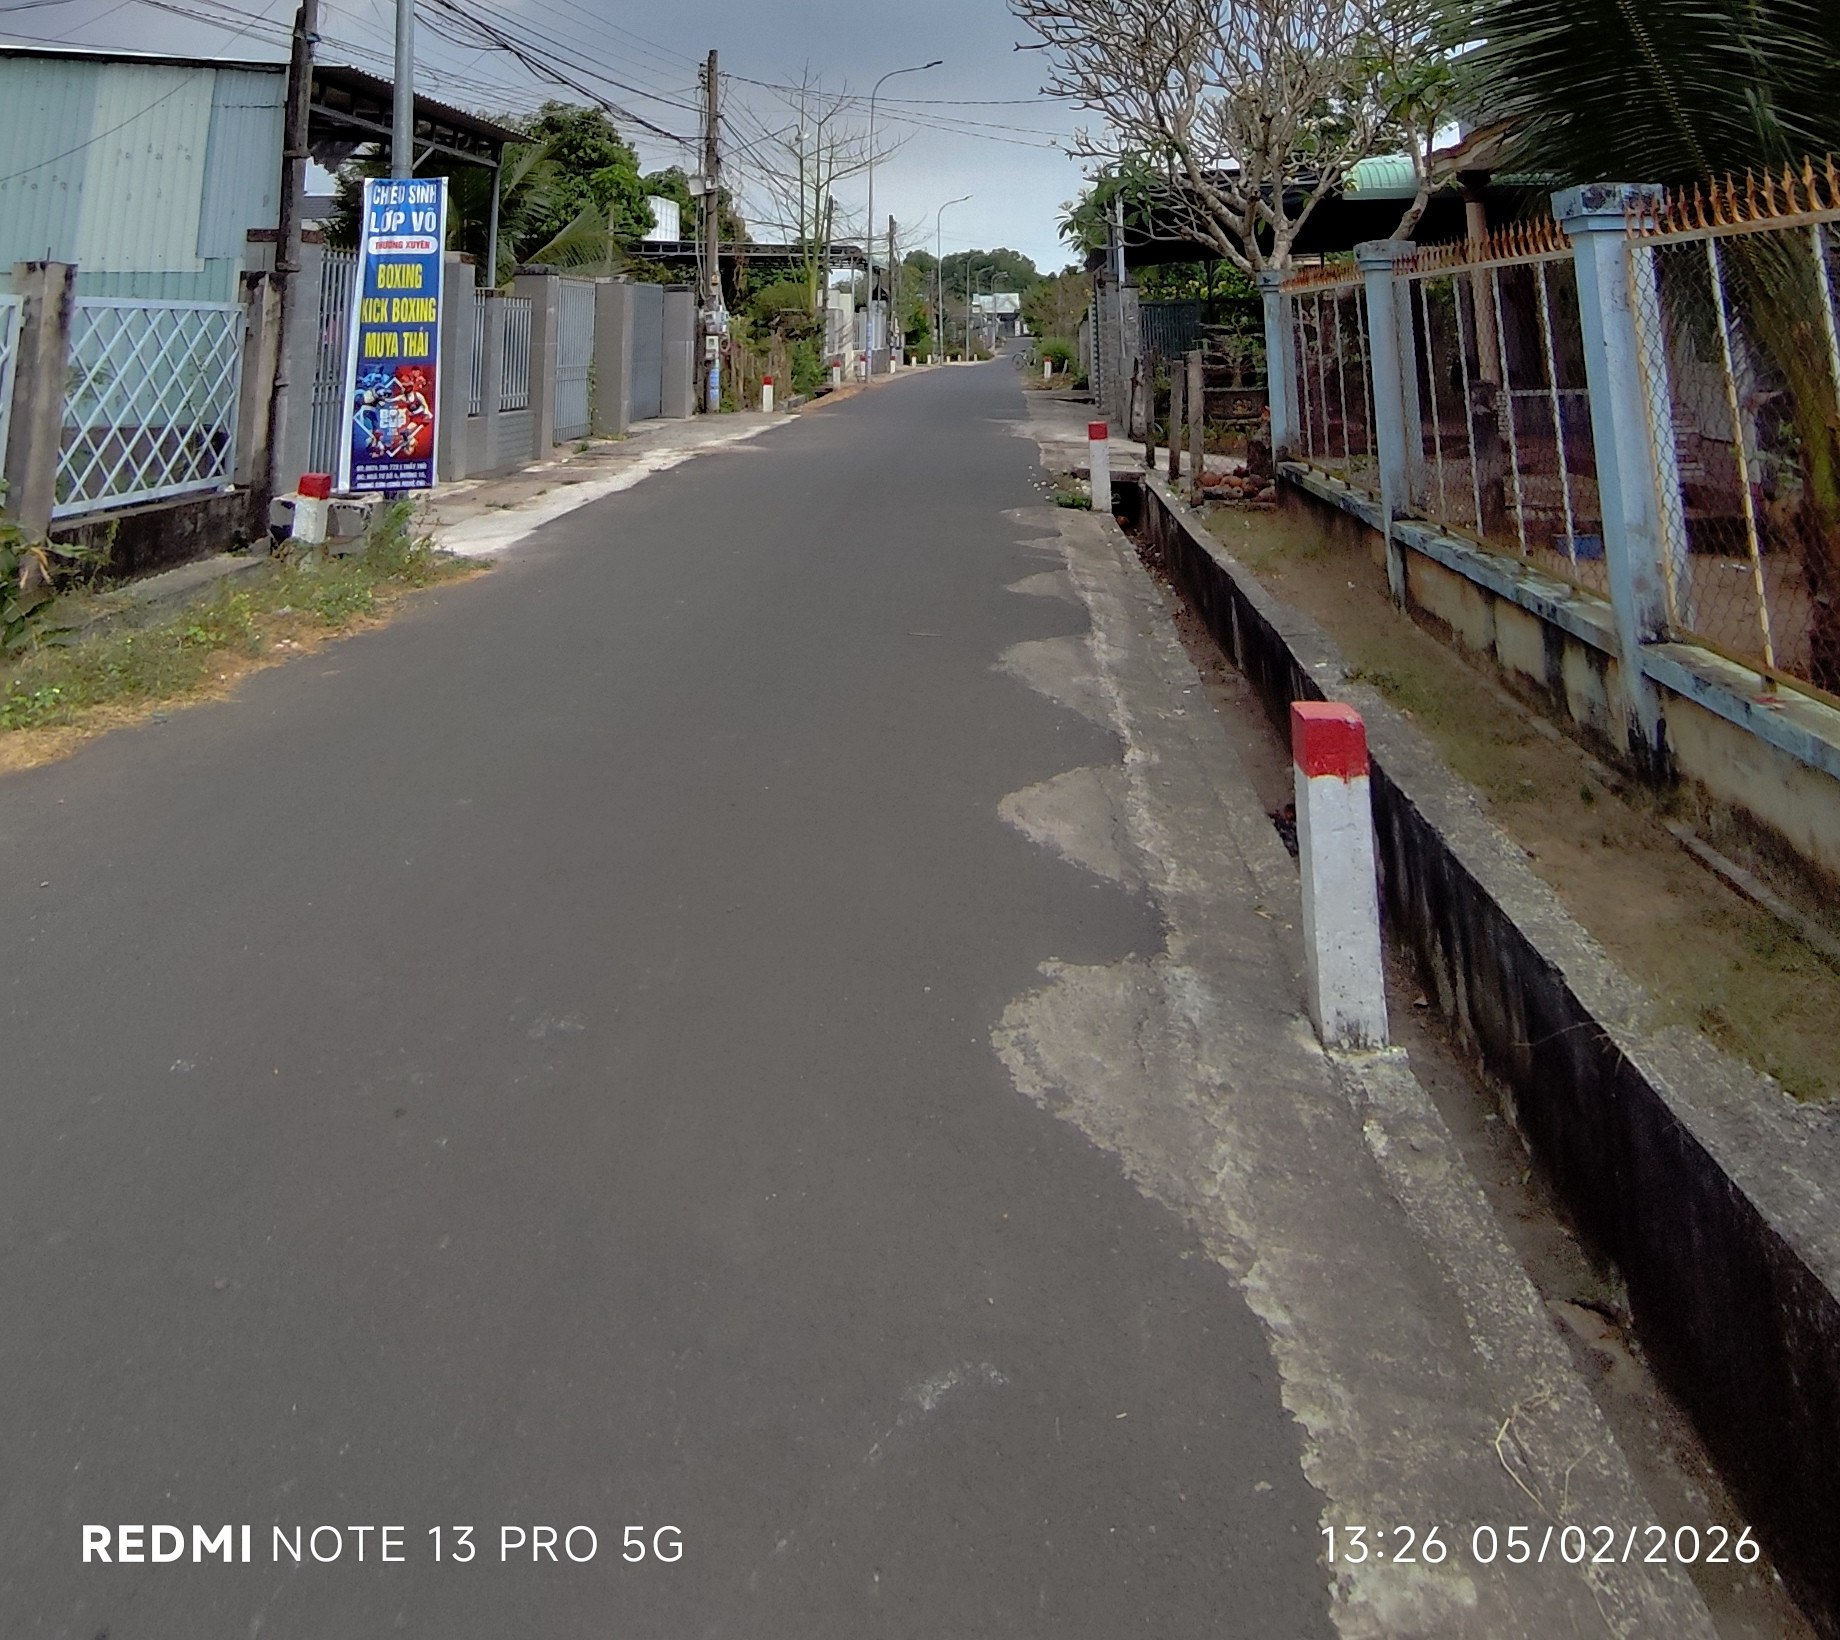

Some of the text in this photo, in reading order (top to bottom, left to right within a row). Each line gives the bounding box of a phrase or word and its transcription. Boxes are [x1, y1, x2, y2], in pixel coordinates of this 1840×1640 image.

[408, 183, 437, 204] SINH
[369, 206, 437, 232] LỚP VÕ
[405, 238, 430, 249] XUYÊN
[377, 263, 423, 288] BOXING
[361, 297, 437, 323] KICK BOXING
[364, 325, 429, 358] MUYA THÁI
